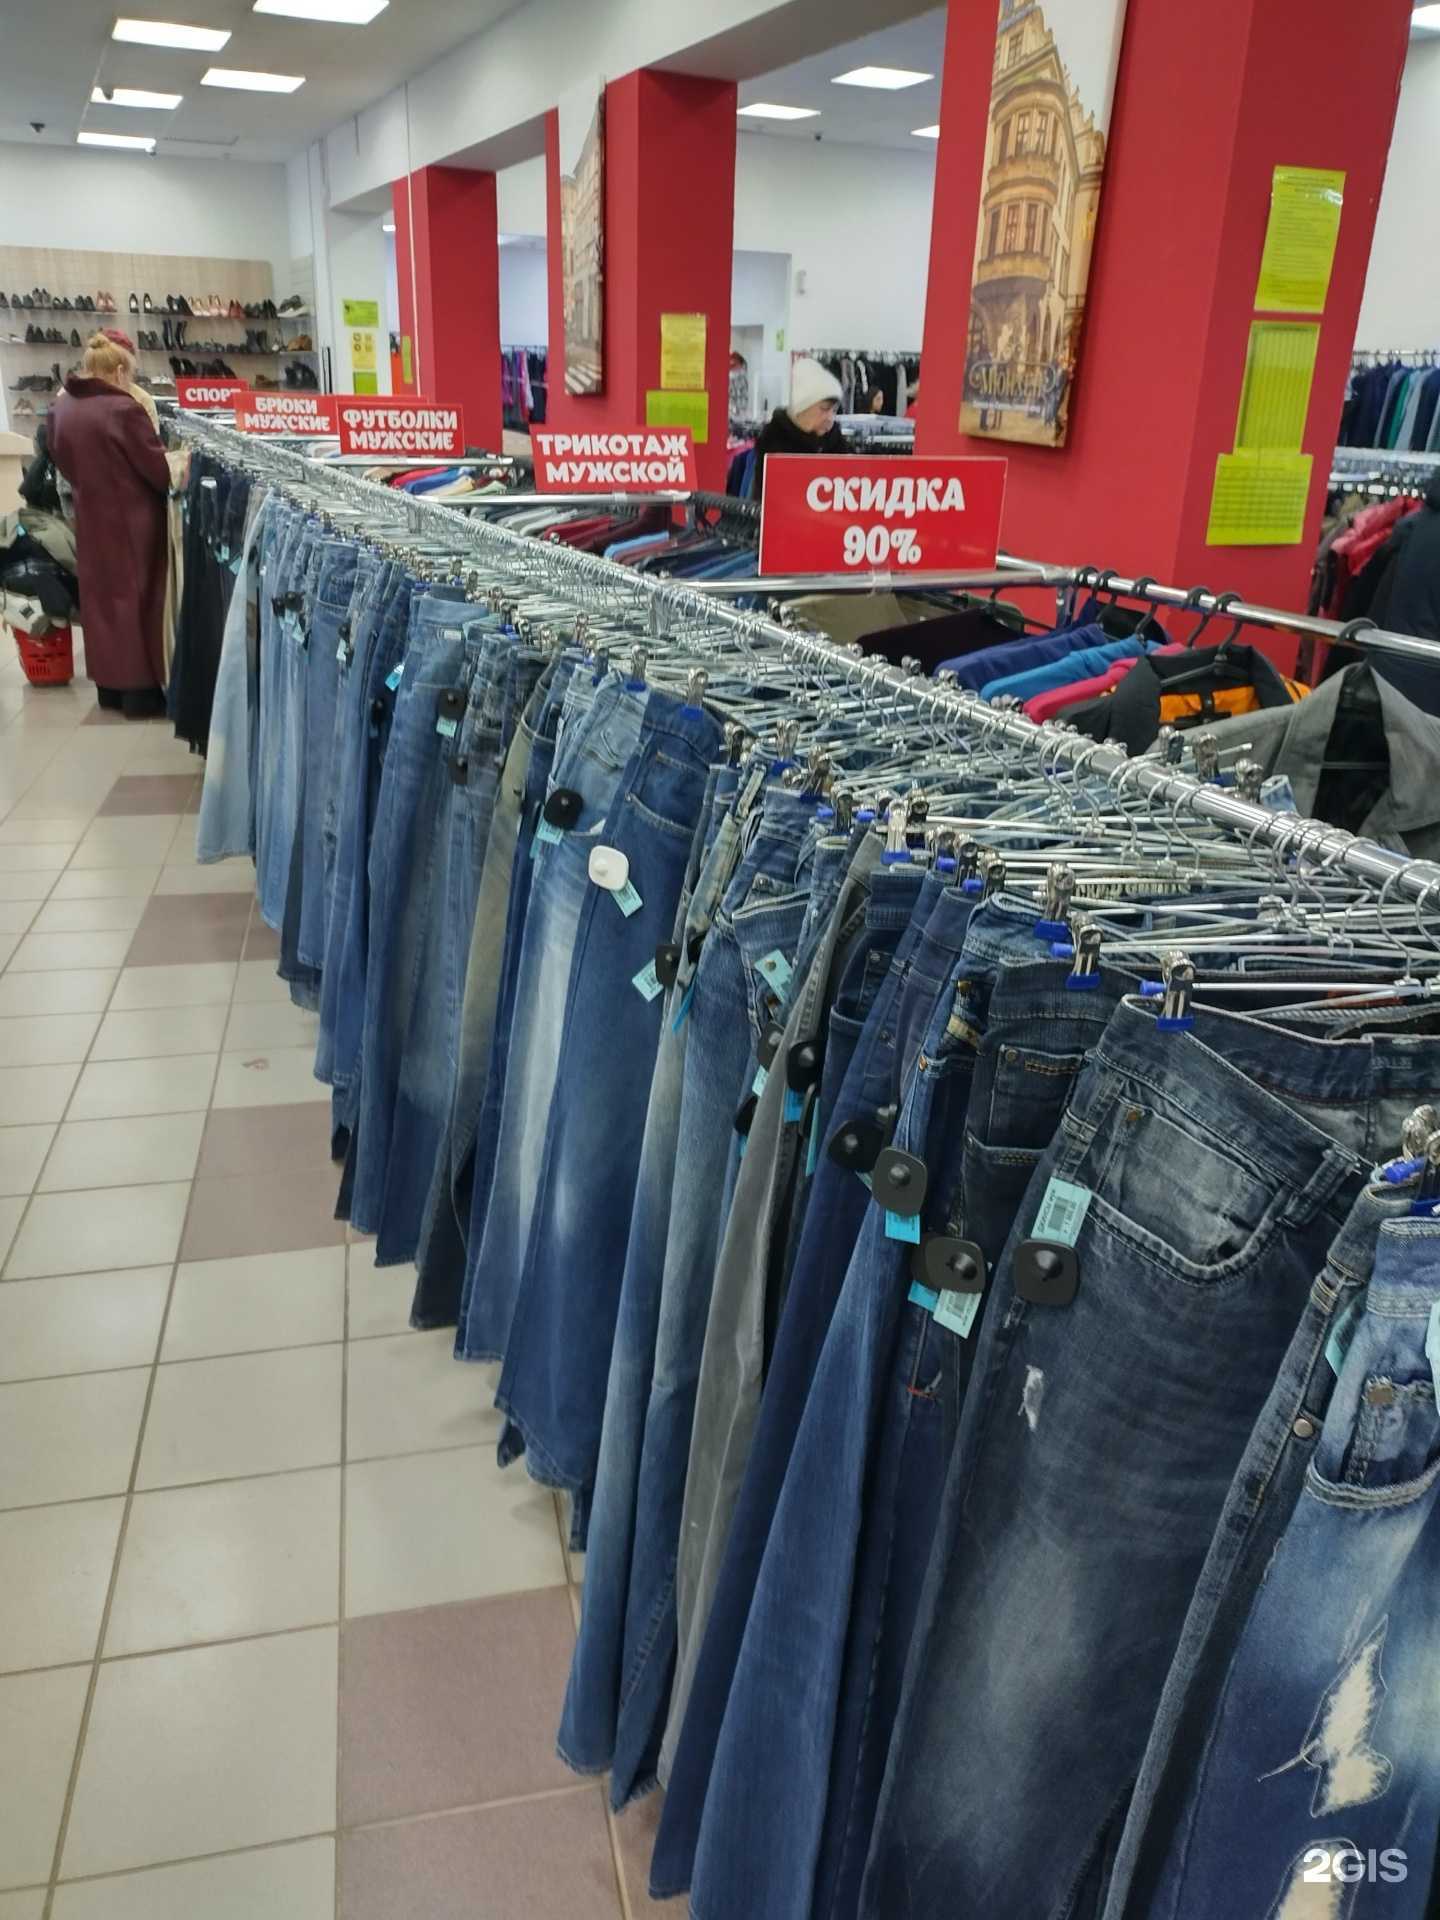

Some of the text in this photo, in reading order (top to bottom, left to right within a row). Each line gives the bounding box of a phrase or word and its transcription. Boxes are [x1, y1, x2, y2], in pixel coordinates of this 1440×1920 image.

[255, 398, 317, 415] БРЮКИ
[244, 414, 330, 432] МУЖСКИЕ
[342, 409, 458, 431] ФУТБОЛКИ
[350, 430, 455, 451] МУЖСКИЕ
[536, 434, 689, 457] ТРИКОТАЖ
[545, 456, 686, 484] МУЖСКОЙ
[805, 477, 966, 518] СКИДКА
[843, 525, 922, 565] 90%
